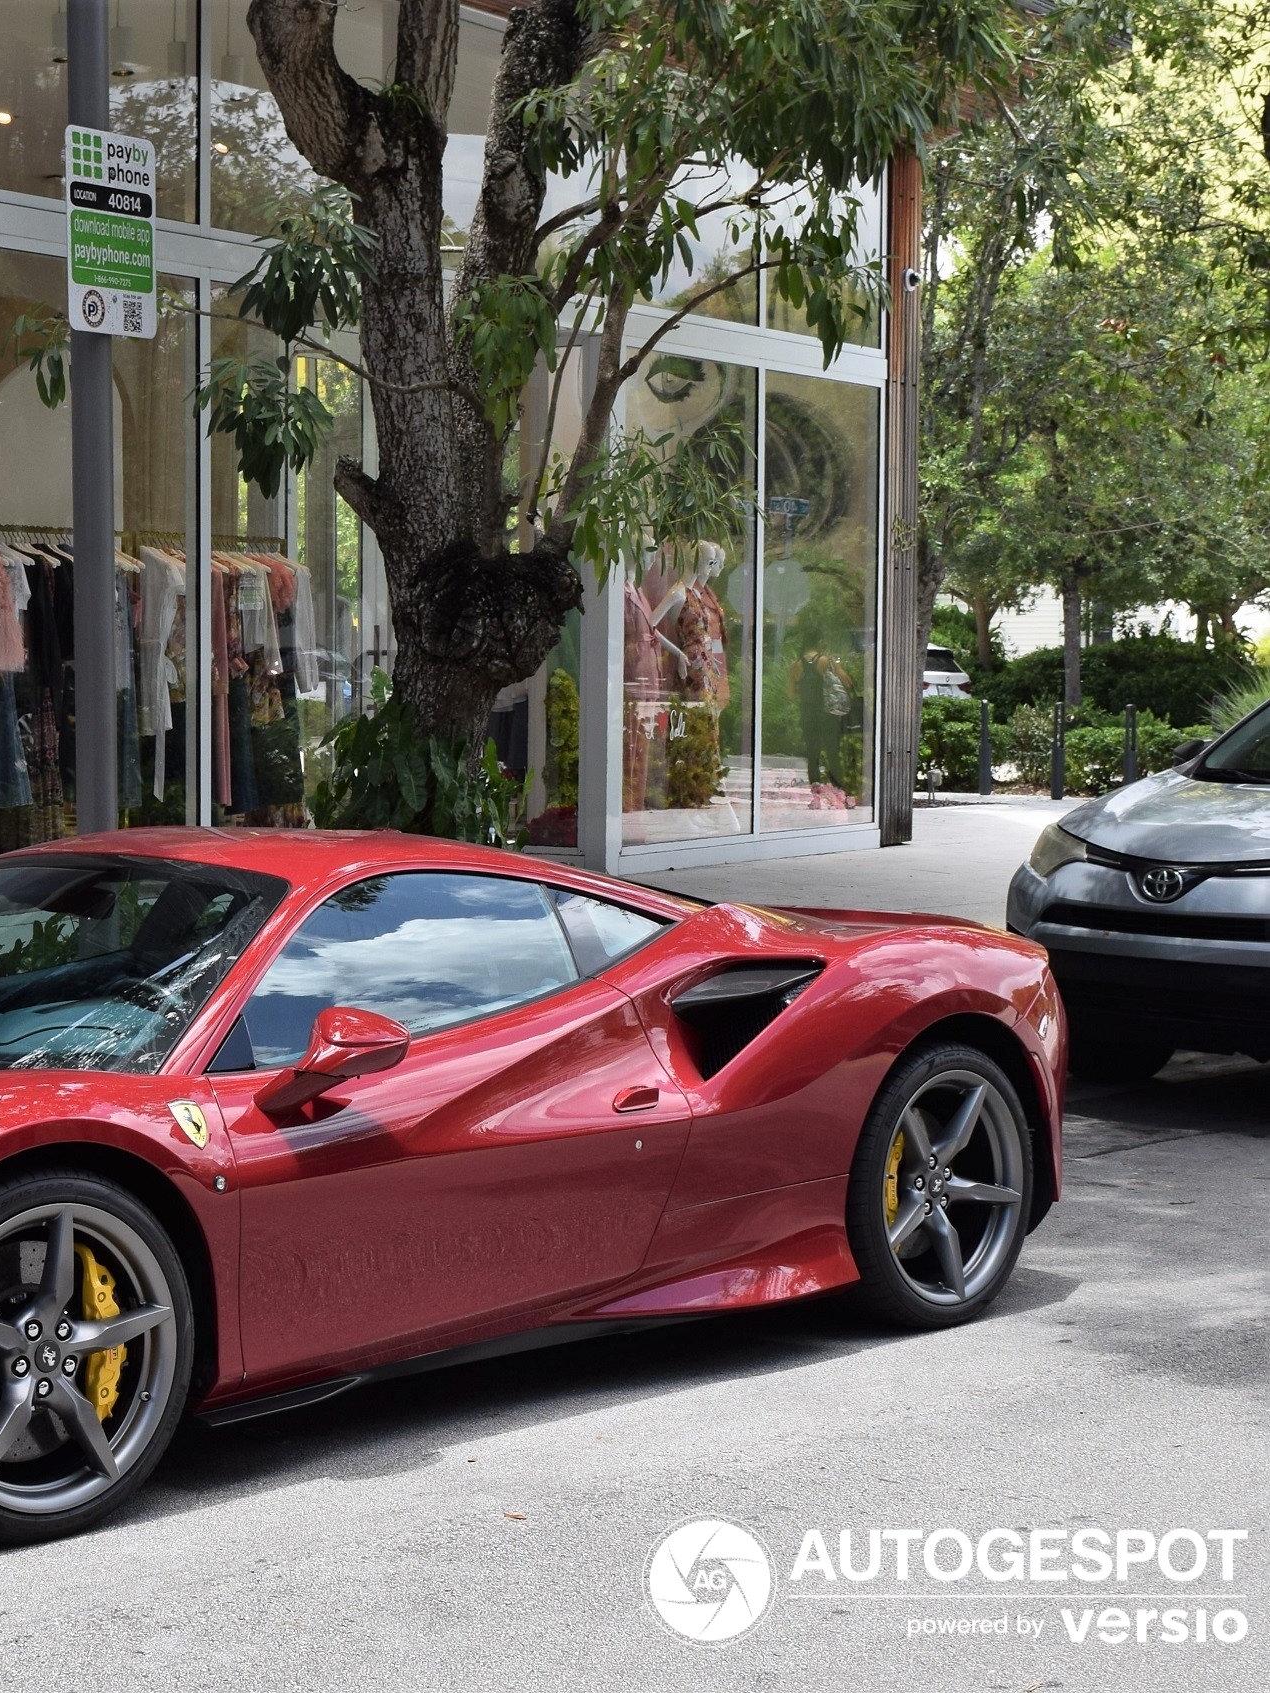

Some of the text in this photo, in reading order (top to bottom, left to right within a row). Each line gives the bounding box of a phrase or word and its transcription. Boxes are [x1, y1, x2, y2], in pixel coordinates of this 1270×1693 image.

[107, 142, 149, 167] payby
[107, 163, 150, 187] phone
[73, 188, 142, 213] LOCATION 40814
[74, 214, 150, 247] download mobile app
[74, 242, 151, 268] paybyphone.com
